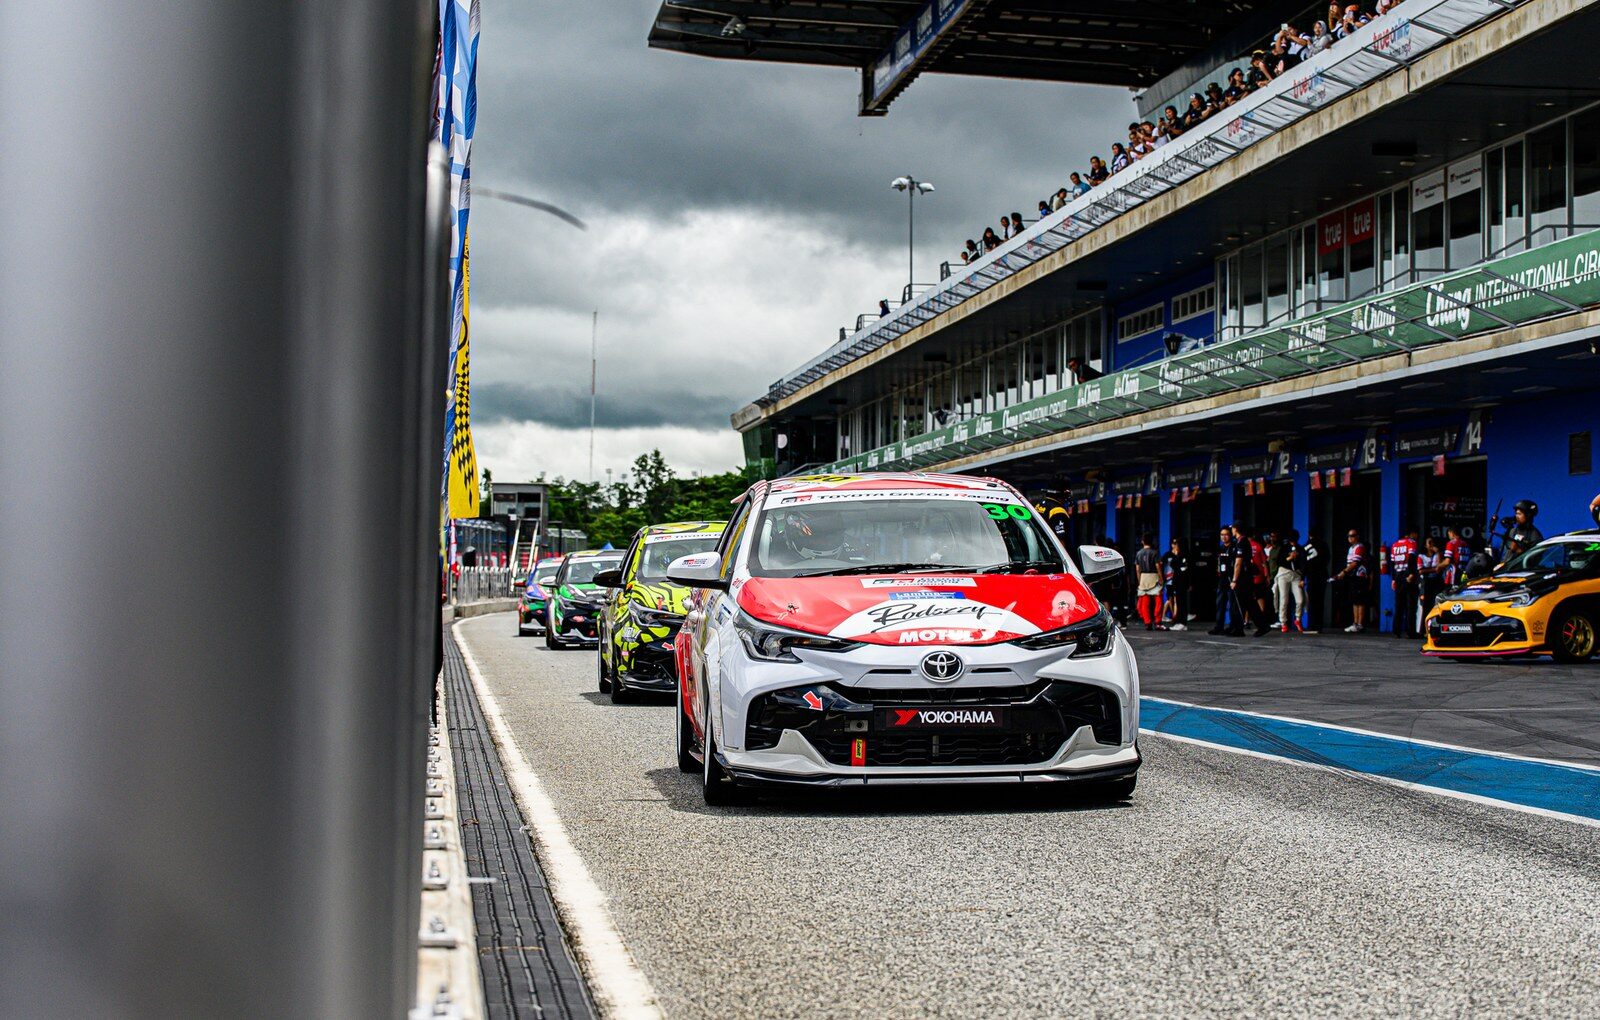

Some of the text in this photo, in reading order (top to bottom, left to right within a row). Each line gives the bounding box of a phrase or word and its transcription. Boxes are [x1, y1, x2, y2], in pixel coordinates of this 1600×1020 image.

[1325, 223, 1342, 246] true
[1353, 211, 1371, 236] true
[1426, 249, 1600, 331] Chang INTERNATIONAL CIR
[1364, 303, 1397, 337] Chang
[1159, 360, 1183, 398] Chang
[1466, 421, 1482, 451] 14
[1280, 451, 1290, 475] 12
[1363, 438, 1377, 465] 13
[1209, 462, 1218, 485] 11
[817, 492, 884, 500] TOYOTA
[981, 503, 1032, 521] 30
[898, 629, 973, 644] MOTUL
[918, 710, 996, 724] YOKOHAMA
